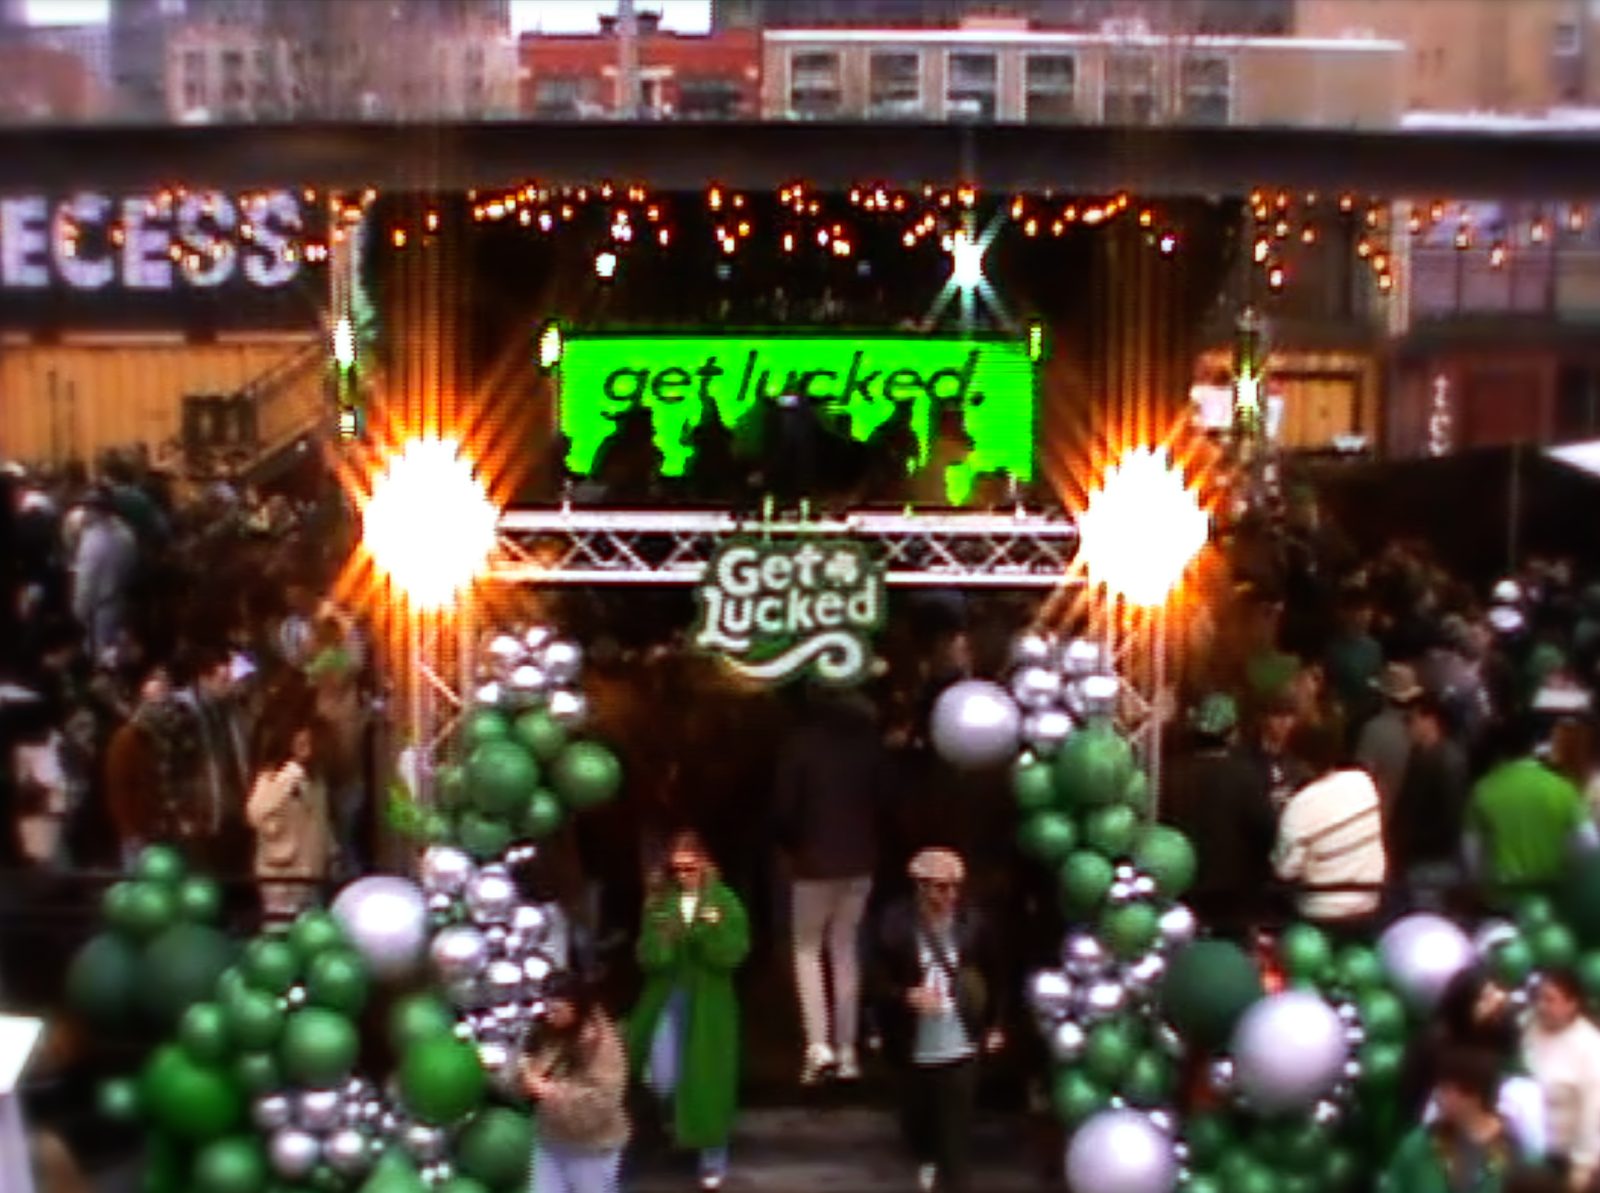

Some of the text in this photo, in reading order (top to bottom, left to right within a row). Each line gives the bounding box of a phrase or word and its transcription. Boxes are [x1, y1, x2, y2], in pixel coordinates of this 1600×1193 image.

[1, 192, 302, 288] ECESS
[600, 349, 985, 421] get lucked.
[717, 544, 823, 597] Get
[696, 573, 878, 651] Lucked
